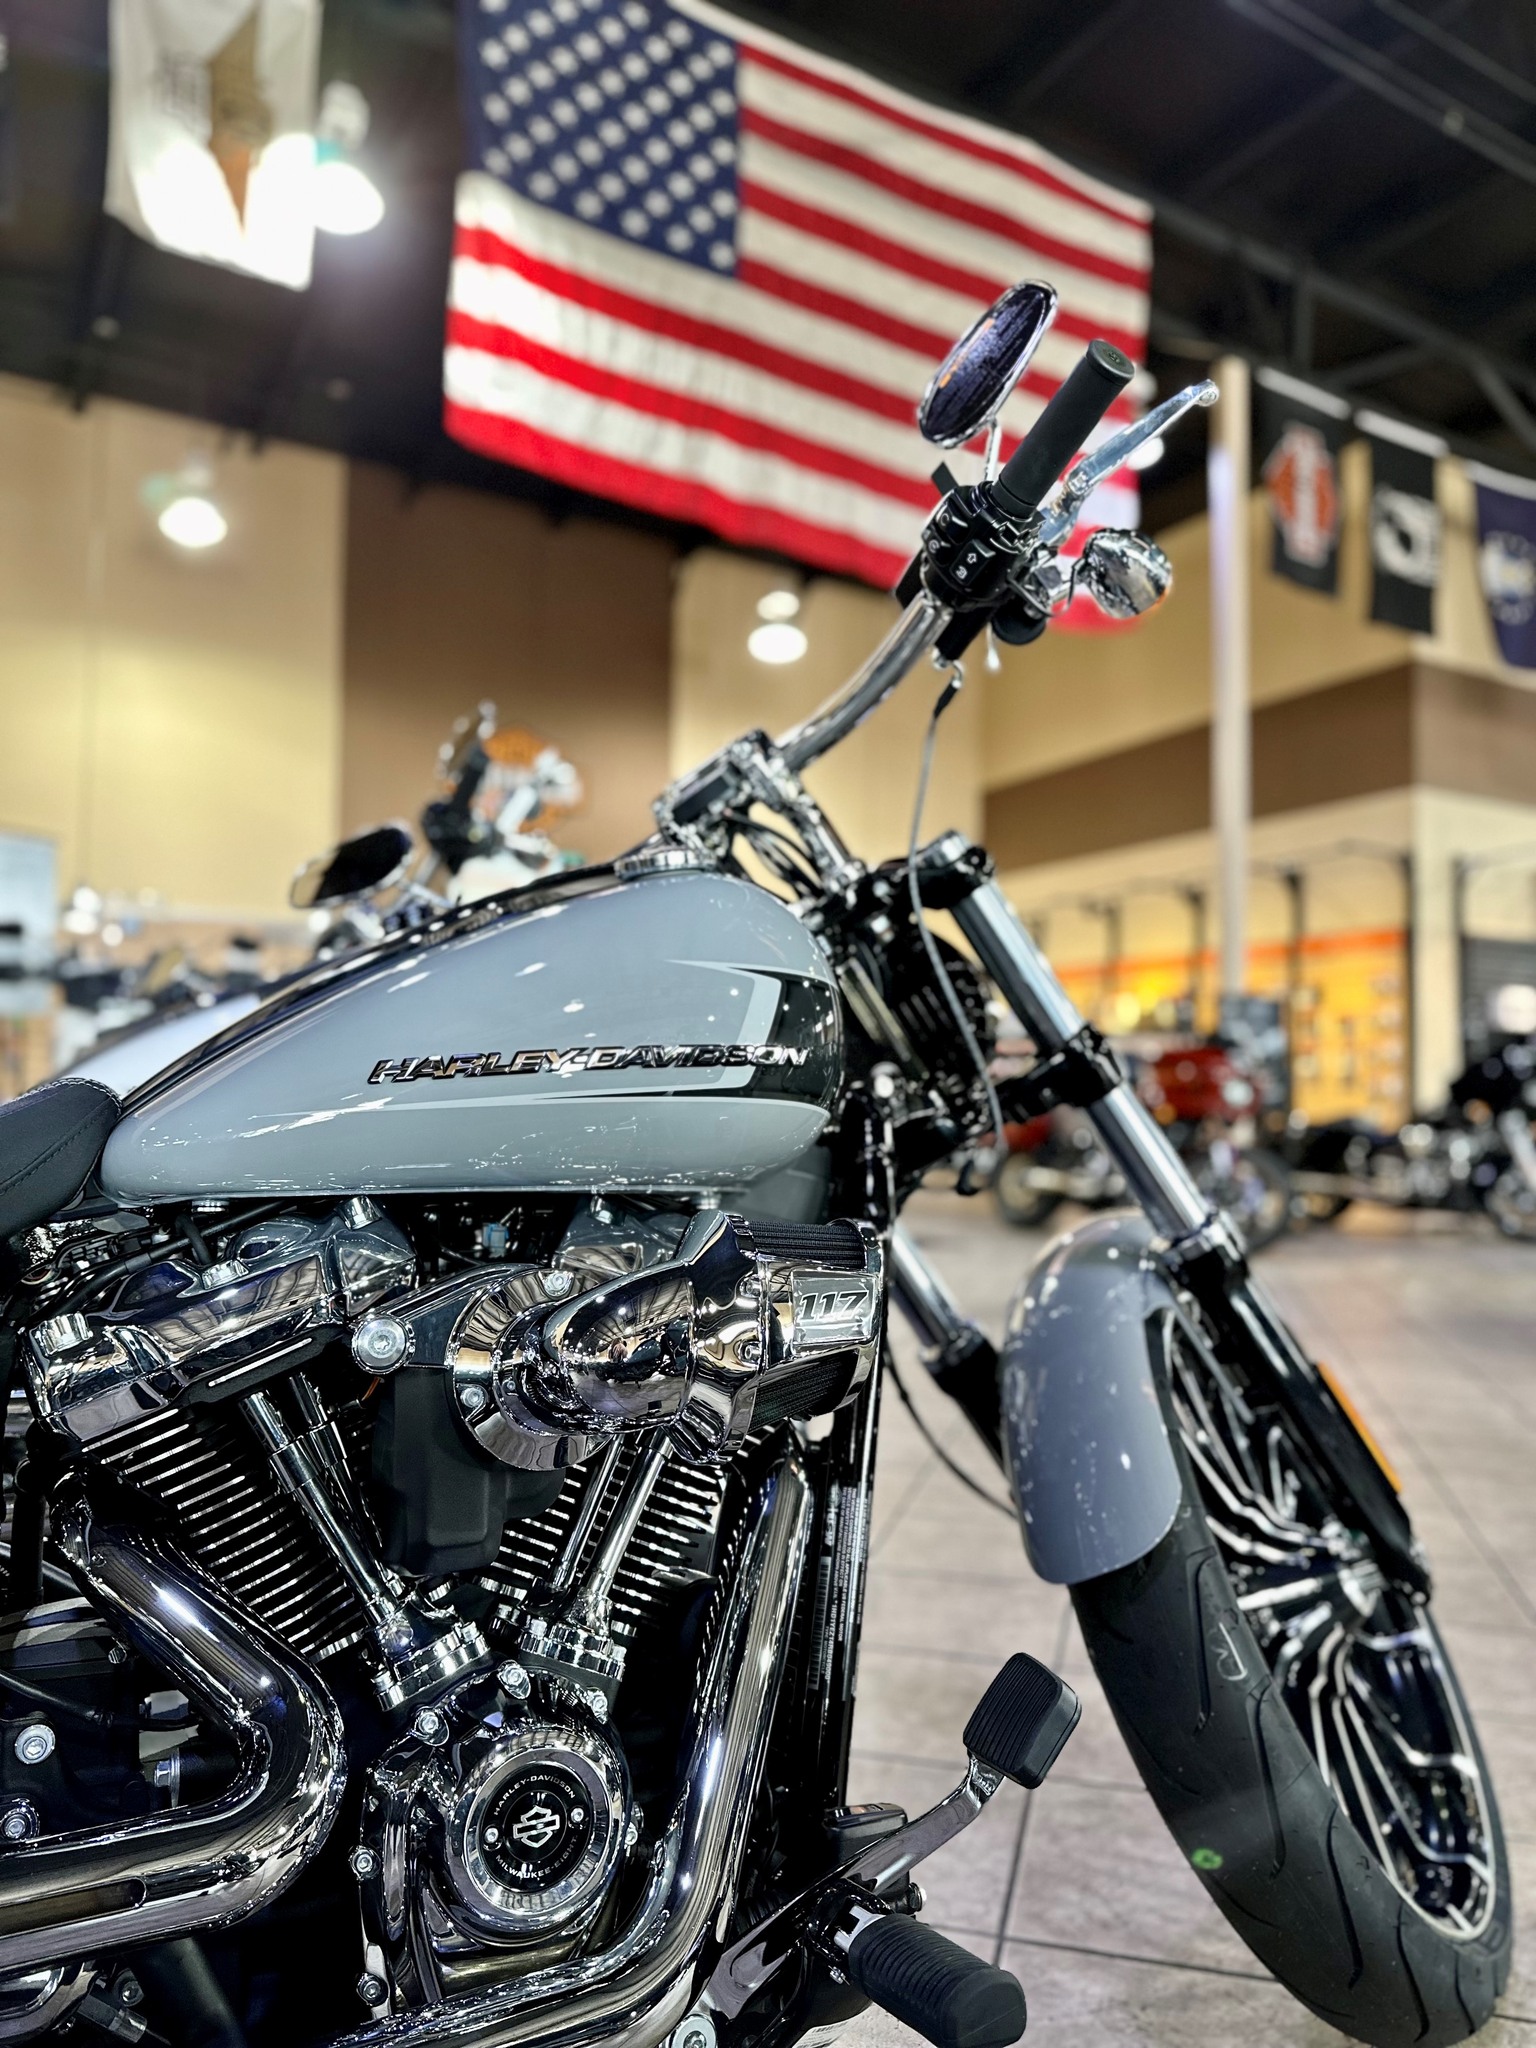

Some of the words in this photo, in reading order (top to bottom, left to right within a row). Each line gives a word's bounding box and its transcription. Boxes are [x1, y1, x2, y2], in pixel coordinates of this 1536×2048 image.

[365, 1043, 810, 1085] HARLEY-DAVIDSON
[801, 1290, 869, 1321] 117
[836, 1516, 844, 1551] MANUFACTURE
[842, 1563, 850, 1591] APPLICABLE
[820, 1640, 828, 1673] MOTORCYCLE
[494, 1775, 576, 1815] HARLEY-DAVIDSON
[495, 1836, 576, 1879] MILWAUKEE-EIGHT
